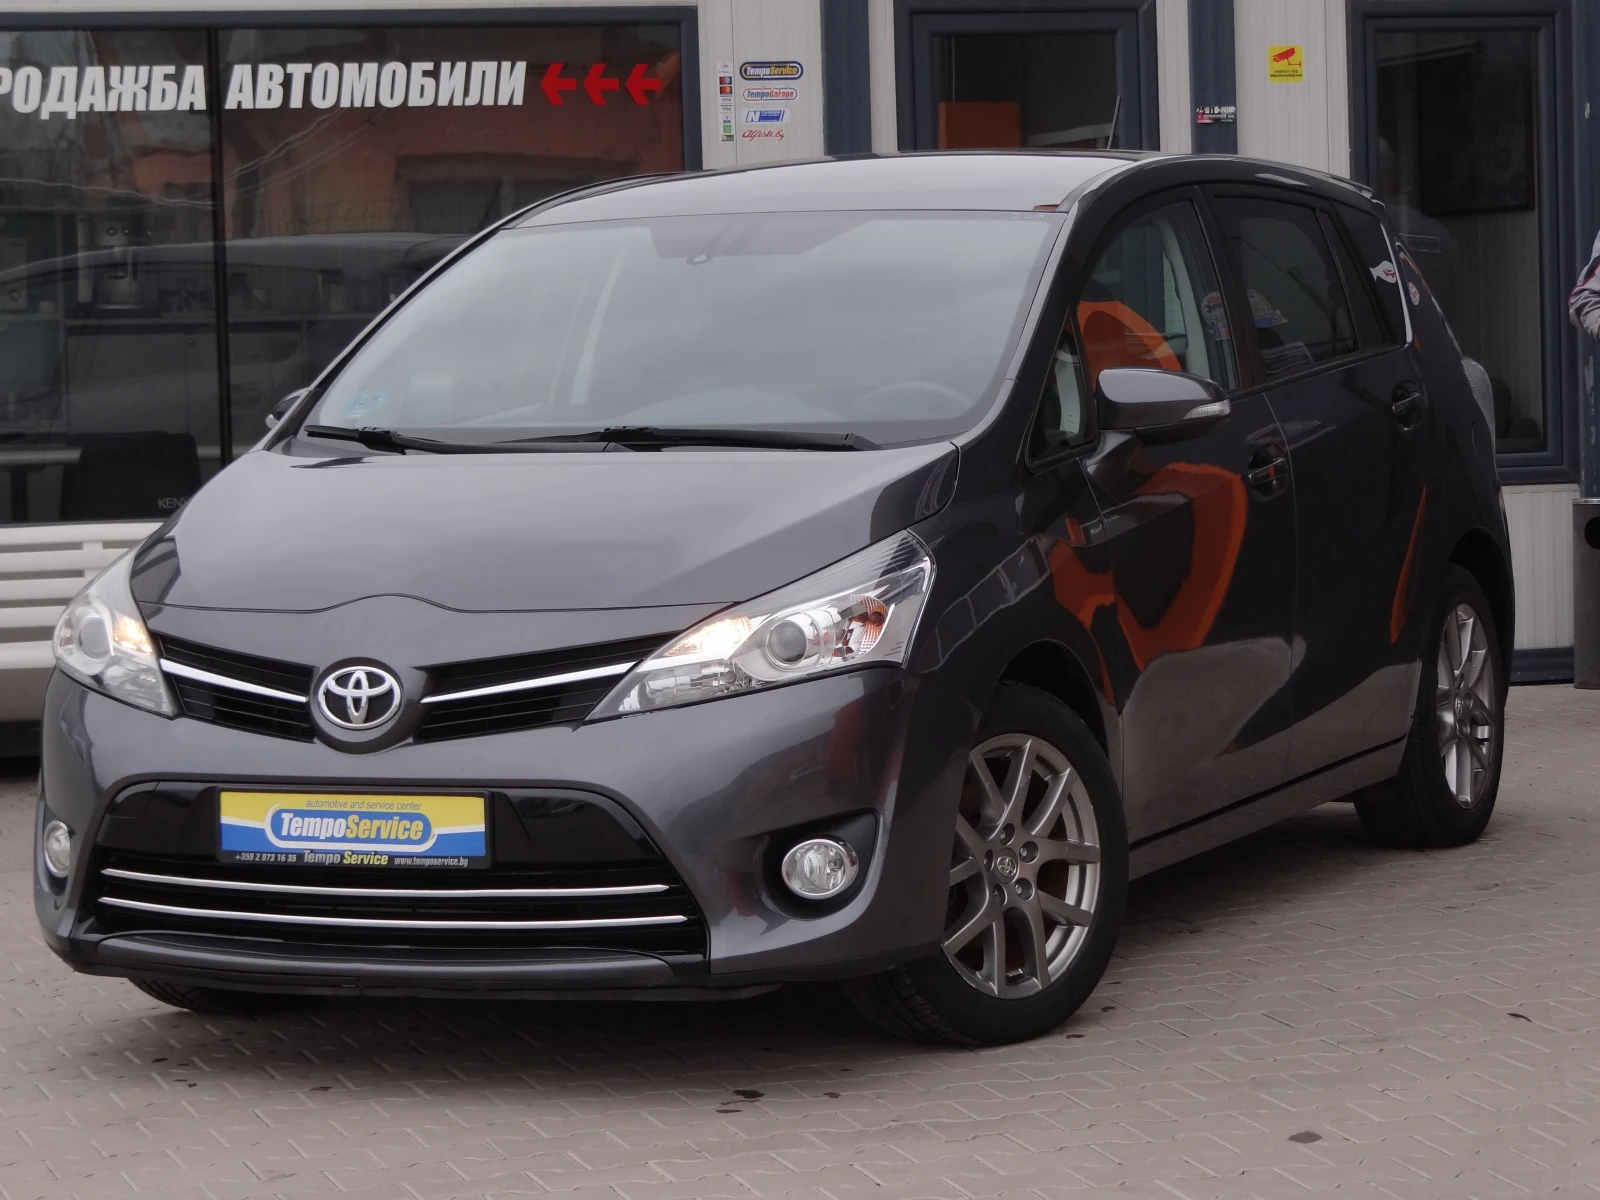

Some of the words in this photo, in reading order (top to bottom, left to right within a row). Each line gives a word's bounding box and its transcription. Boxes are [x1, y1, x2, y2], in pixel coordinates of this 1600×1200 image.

[746, 65, 798, 78] TempoService
[224, 60, 527, 109] АВТОМОБИЛИ
[747, 90, 795, 100] TempoGarage
[306, 799, 348, 809] automotive
[350, 800, 364, 809] and
[366, 801, 394, 810] service
[396, 802, 422, 811] center
[281, 813, 424, 840] TempoService
[235, 852, 255, 862] +359
[255, 853, 261, 862] 2
[261, 853, 275, 862] 973
[277, 854, 286, 862] 16
[287, 854, 297, 863] 35
[303, 849, 341, 866] Tempo
[342, 850, 389, 866] Service
[394, 856, 469, 868] www.temposervice.bg
